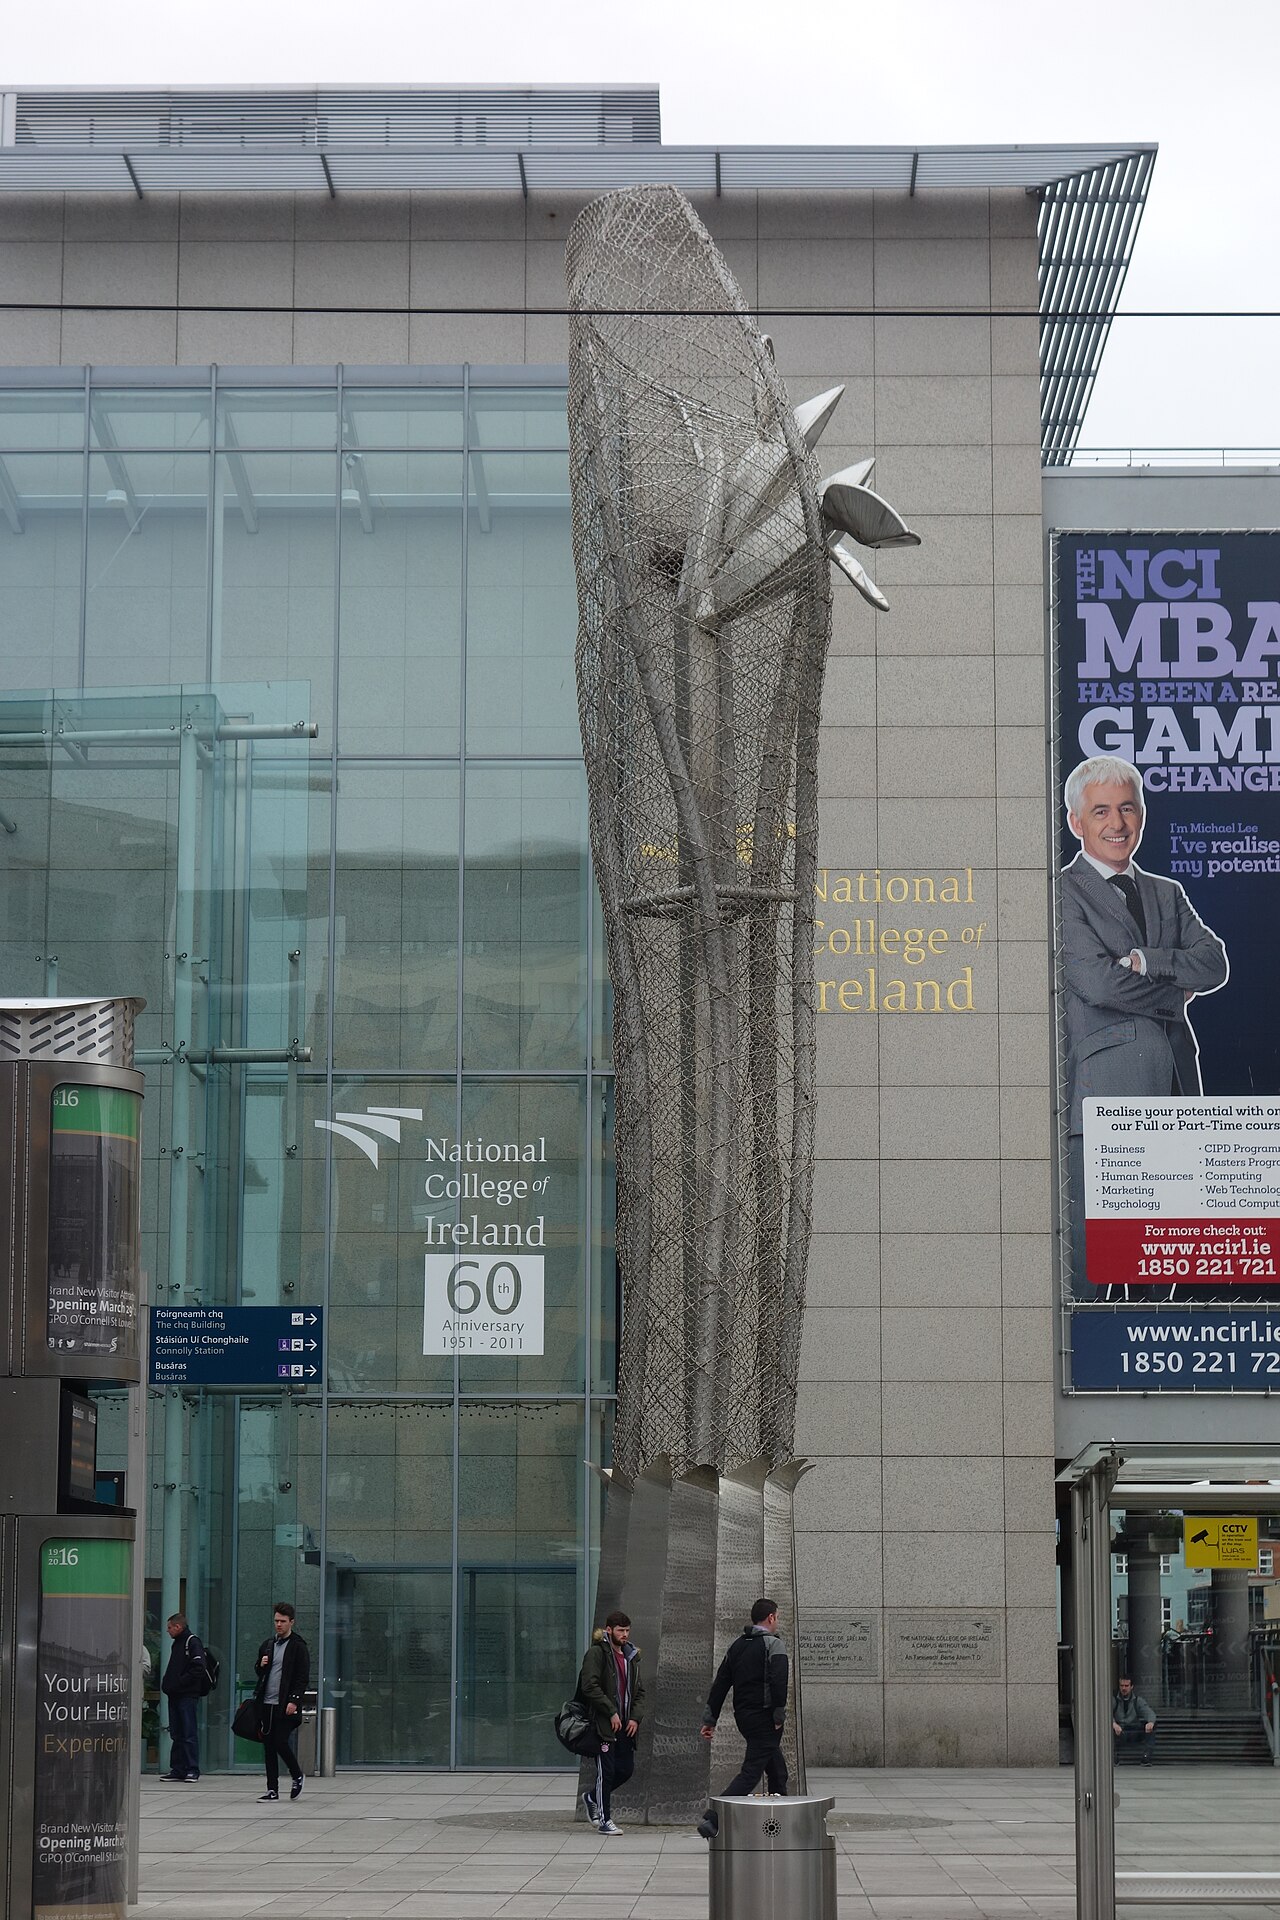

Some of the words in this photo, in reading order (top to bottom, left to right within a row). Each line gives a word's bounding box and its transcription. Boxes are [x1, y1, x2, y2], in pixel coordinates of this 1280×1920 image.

[1076, 549, 1096, 600] THE
[1098, 549, 1221, 600] NCI
[1076, 601, 1280, 679] MBA
[1077, 682, 1136, 703] HAS
[1140, 682, 1214, 703] BEEN
[1218, 682, 1239, 703] A
[1242, 681, 1280, 703] RE
[1170, 823, 1188, 834] I'm
[1190, 823, 1236, 834] Michael
[1238, 823, 1258, 833] Lee
[1170, 836, 1207, 854] I've
[1211, 835, 1280, 854] realise
[1170, 860, 1203, 878] my
[961, 922, 988, 949] of
[816, 966, 977, 1013] reland
[59, 1088, 79, 1107] 16
[1096, 1106, 1142, 1117] Realise
[1144, 1108, 1174, 1119] your
[1176, 1106, 1233, 1119] potential
[1236, 1105, 1264, 1116] with
[1111, 1123, 1132, 1131] our
[1135, 1120, 1159, 1131] Full
[1161, 1123, 1175, 1131] or
[1178, 1120, 1242, 1131] Part-Time
[425, 1137, 547, 1163] National
[1100, 1145, 1146, 1154] Business
[1204, 1144, 1231, 1153] CIPD
[1233, 1144, 1280, 1155] Program
[1101, 1158, 1142, 1167] Finance
[1205, 1158, 1246, 1166] Masters
[1101, 1172, 1139, 1181] Human
[1141, 1172, 1194, 1181] Resources
[1205, 1171, 1262, 1183] Computing
[424, 1173, 528, 1206] College
[532, 1175, 550, 1195] of
[1101, 1186, 1155, 1197] Marketing
[1205, 1185, 1228, 1194] Web
[1102, 1199, 1161, 1211] Psychology
[1206, 1199, 1237, 1208] Cloud
[424, 1215, 547, 1247] Ireland
[1145, 1224, 1166, 1236] For
[1168, 1227, 1200, 1236] more
[1203, 1224, 1240, 1236] check
[1243, 1227, 1267, 1236] out:
[1141, 1238, 1271, 1256] www.ncirl.ie
[1137, 1259, 1190, 1276] 1850
[1196, 1258, 1235, 1276] 221
[1239, 1258, 1277, 1276] 721
[76, 1286, 97, 1297] New
[97, 1287, 120, 1299] Visitor
[446, 1260, 523, 1316] 60
[497, 1282, 510, 1295] th
[99, 1300, 125, 1314] March
[70, 1314, 110, 1326] O'Connell
[110, 1316, 117, 1327] St
[156, 1310, 206, 1319] Foirgneamh
[208, 1310, 224, 1320] chq
[156, 1321, 172, 1329] The
[173, 1321, 189, 1331] chq
[191, 1321, 226, 1331] Building
[441, 1319, 525, 1335] Anniversary
[155, 1336, 188, 1344] Stáisiún
[201, 1336, 250, 1346] Chonghaile
[442, 1336, 473, 1349] 1951
[489, 1336, 524, 1349] 2011
[155, 1347, 192, 1356] Connolly
[194, 1347, 224, 1355] Station
[155, 1361, 187, 1370] Busáras
[1120, 1352, 1184, 1373] 1850
[1192, 1352, 1236, 1373] 221
[1250, 1352, 1280, 1373] 72
[155, 1372, 187, 1381] Busáras
[1222, 1524, 1248, 1533] CCTV
[48, 1548, 58, 1556] 19
[59, 1548, 79, 1566] 16
[48, 1558, 58, 1566] 20
[44, 1673, 90, 1693] Your
[44, 1702, 90, 1721] Your
[40, 1823, 69, 1834] Brand
[70, 1824, 90, 1834] New
[91, 1822, 114, 1833] Visitor
[40, 1836, 92, 1852] Opening
[93, 1834, 120, 1848] March
[40, 1852, 63, 1864] GPO,
[64, 1852, 104, 1863] O'Connell
[106, 1852, 112, 1862] St
